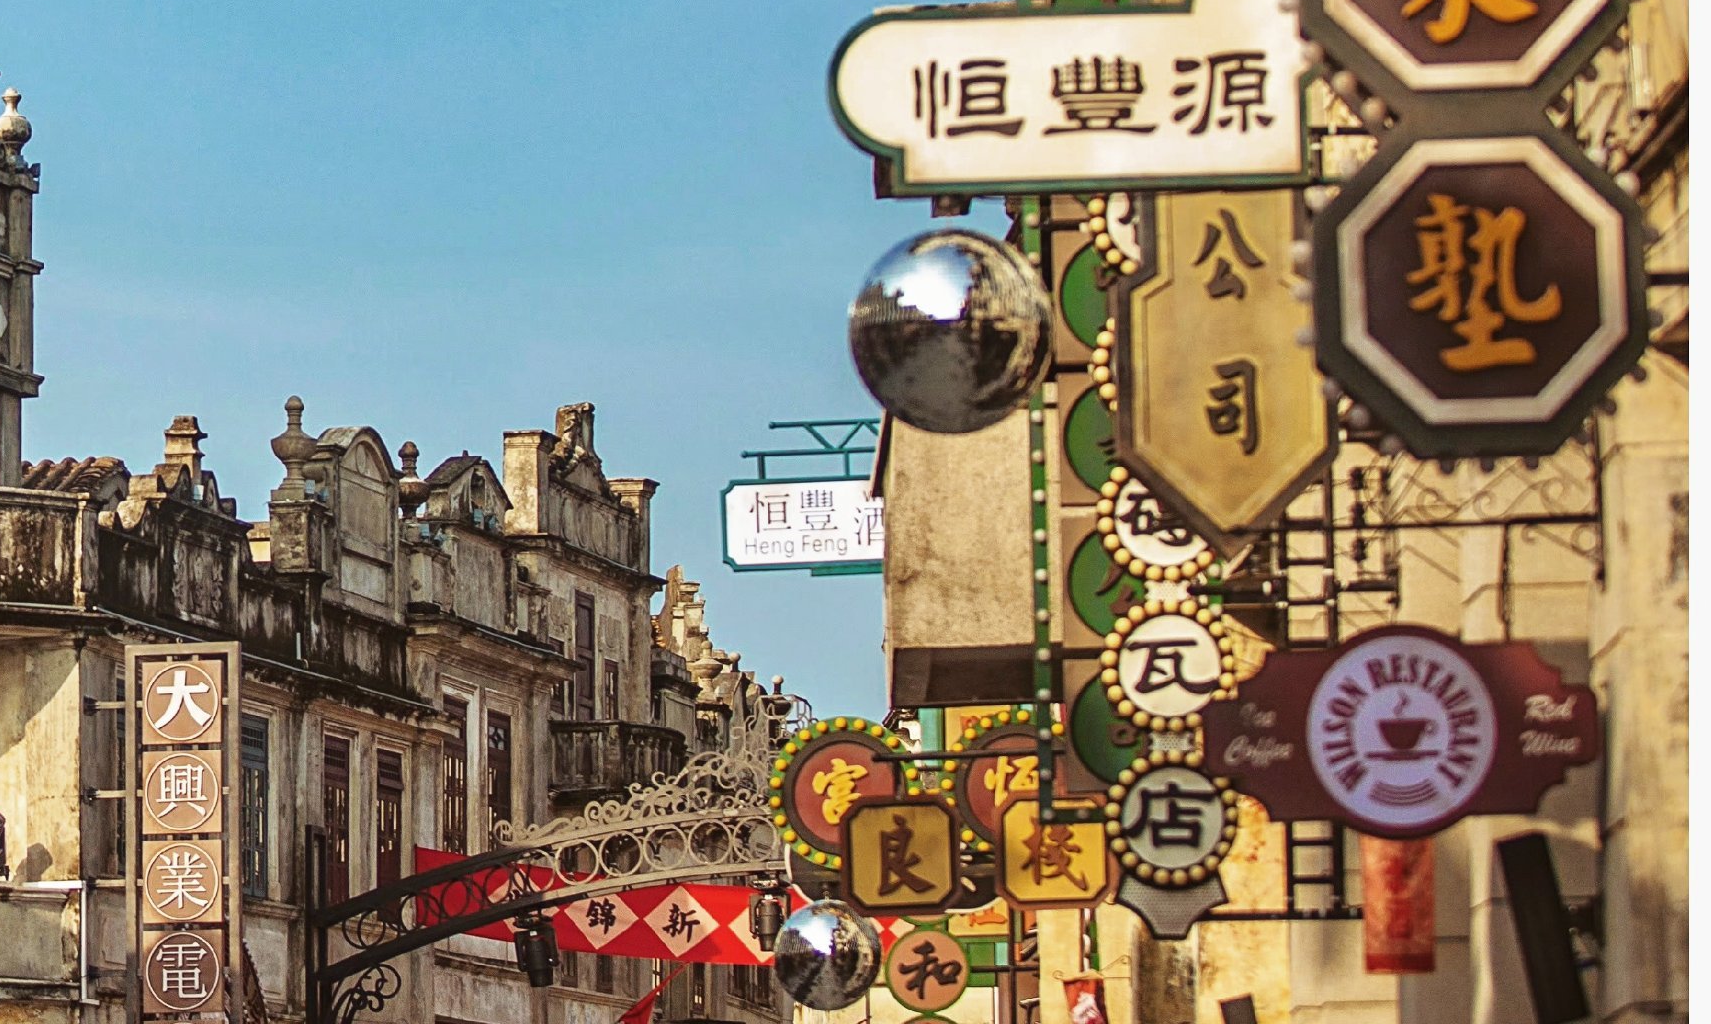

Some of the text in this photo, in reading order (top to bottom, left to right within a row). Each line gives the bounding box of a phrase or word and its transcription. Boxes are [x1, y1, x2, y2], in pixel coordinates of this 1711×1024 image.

[913, 50, 1274, 139] 恒豐源
[746, 535, 848, 557] Heng Feng
[1322, 653, 1480, 792] WILSON RESTAURANT
[1523, 693, 1578, 723] Red
[1519, 729, 1581, 755] Wine
